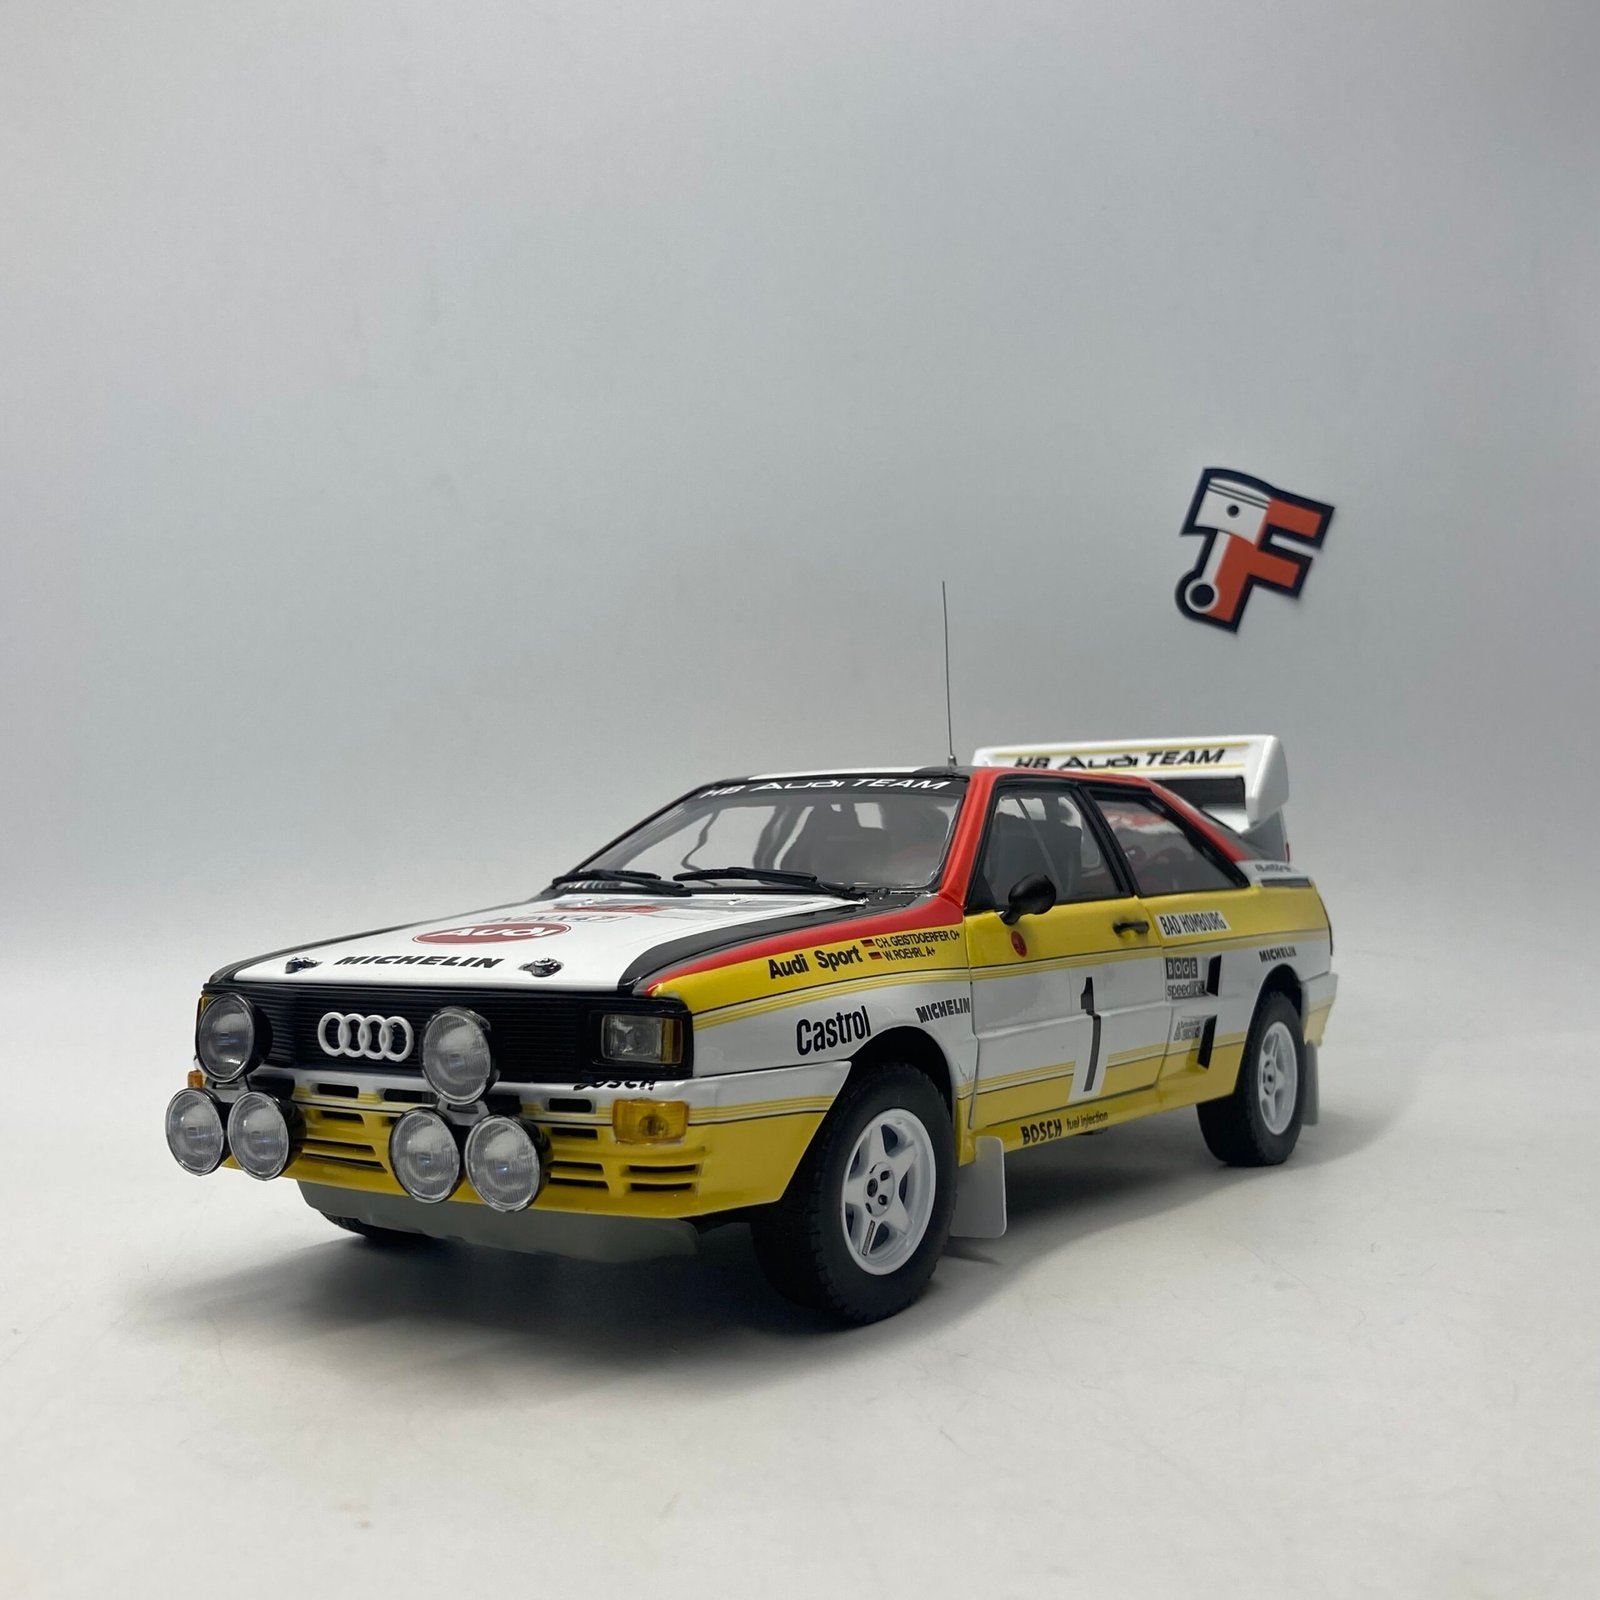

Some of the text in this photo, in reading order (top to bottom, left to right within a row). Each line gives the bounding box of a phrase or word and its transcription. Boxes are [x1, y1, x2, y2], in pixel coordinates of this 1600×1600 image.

[1146, 748, 1224, 766] TEAM
[851, 778, 951, 790] TEAM
[438, 927, 554, 937] Audi
[1160, 915, 1180, 936] BAD
[890, 932, 949, 946] GEISTDOERFER
[334, 955, 504, 968] MICHELIN
[768, 945, 863, 979] Audi Sport
[1259, 947, 1297, 963] MICHELIN
[1166, 957, 1198, 979] BOGE
[916, 998, 970, 1023] MICHELIN
[796, 1005, 871, 1056] Castrol
[1080, 976, 1101, 1092] 1
[1021, 1111, 1109, 1145] BOSCH fuel injection
